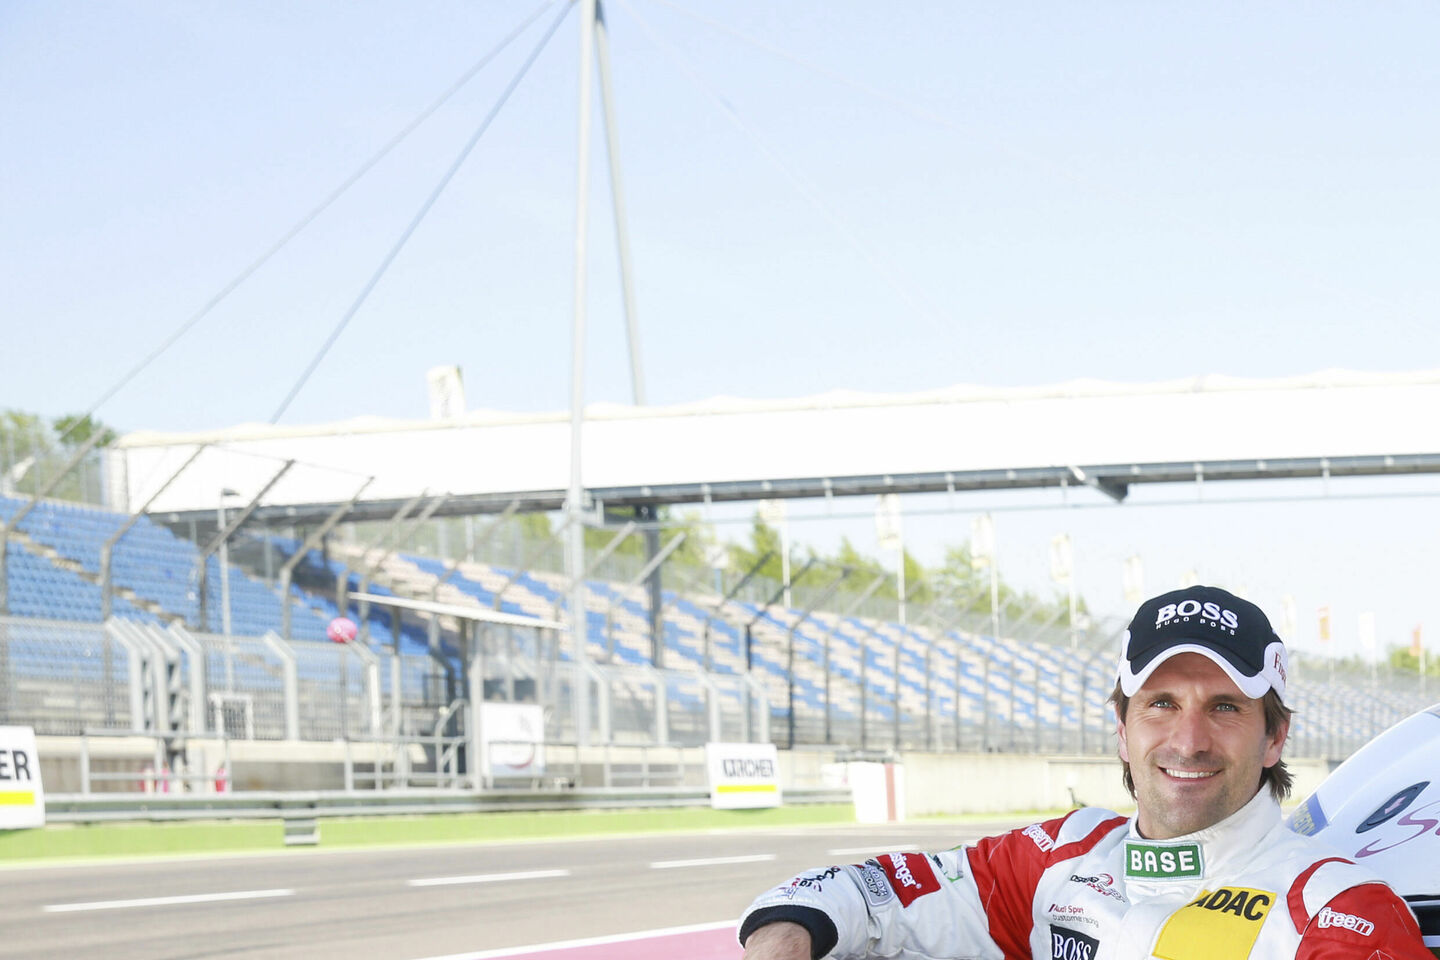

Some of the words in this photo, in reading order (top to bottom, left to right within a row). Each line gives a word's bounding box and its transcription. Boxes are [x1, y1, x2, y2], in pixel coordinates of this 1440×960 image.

[1156, 600, 1239, 629] BOSS
[1156, 616, 1190, 630] HUGO
[1199, 618, 1236, 636] BOSS
[1130, 849, 1196, 874] BASE
[1317, 907, 1375, 937] freem
